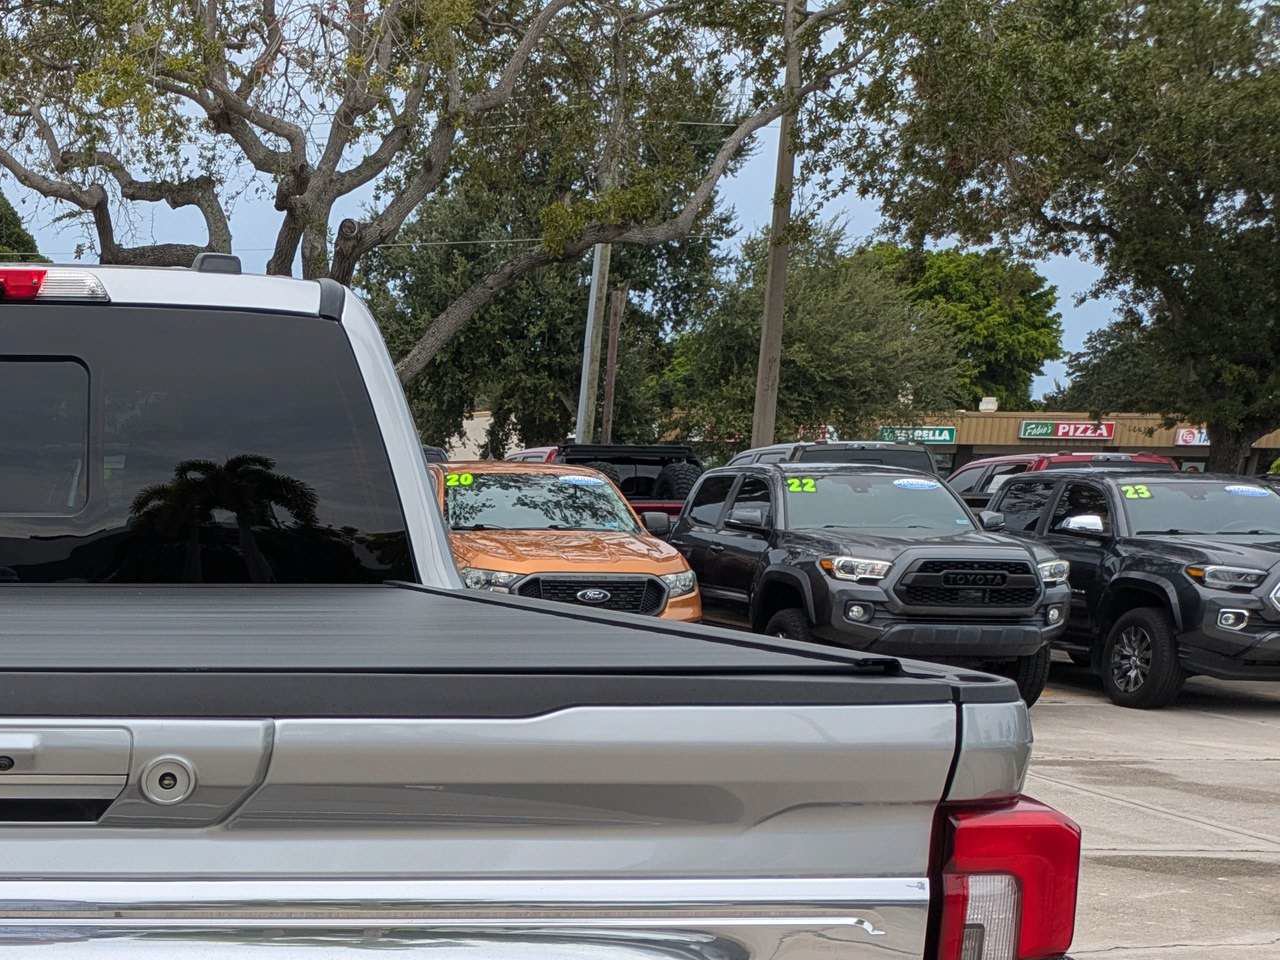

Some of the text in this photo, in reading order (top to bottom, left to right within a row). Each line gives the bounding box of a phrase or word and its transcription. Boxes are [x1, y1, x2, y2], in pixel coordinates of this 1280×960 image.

[1057, 424, 1108, 437] PIZZA
[446, 474, 474, 487] 20
[787, 478, 817, 493] 22
[1121, 485, 1153, 499] 23
[949, 575, 1003, 586] TOYOTA
